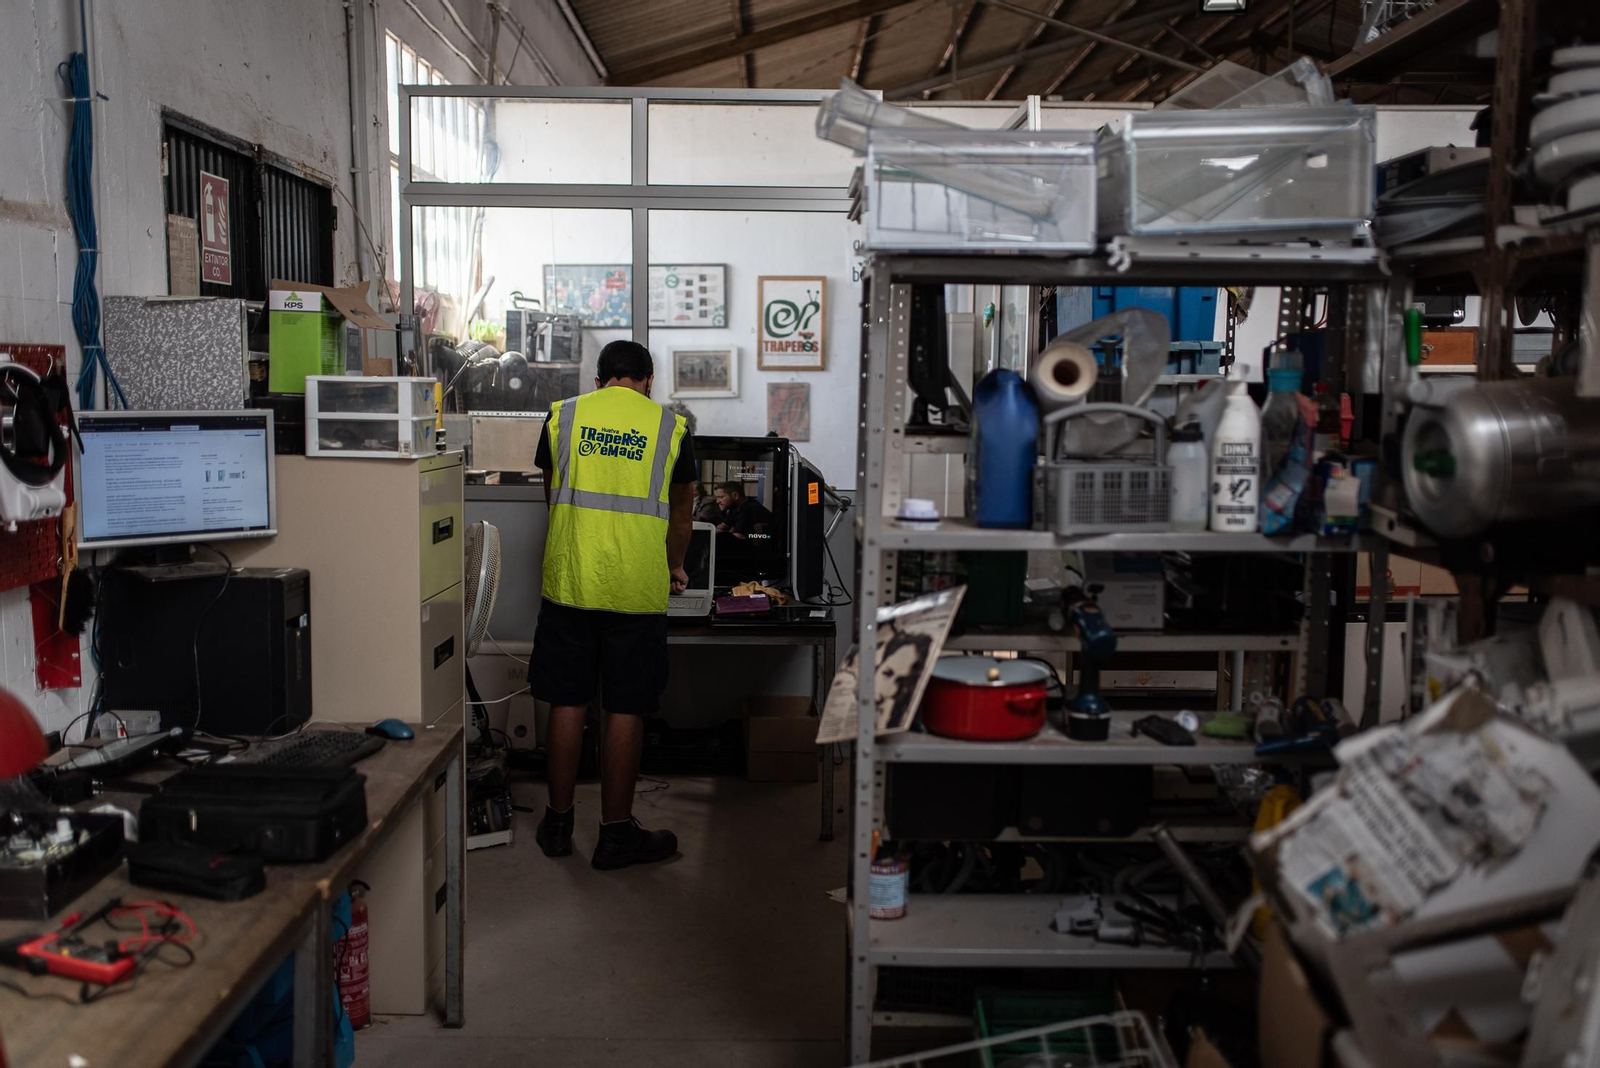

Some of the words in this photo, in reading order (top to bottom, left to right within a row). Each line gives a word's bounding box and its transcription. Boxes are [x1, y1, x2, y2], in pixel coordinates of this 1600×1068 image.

[205, 252, 229, 266] EXTINTOR
[284, 301, 303, 309] KPS
[763, 340, 819, 353] TRAPEROS
